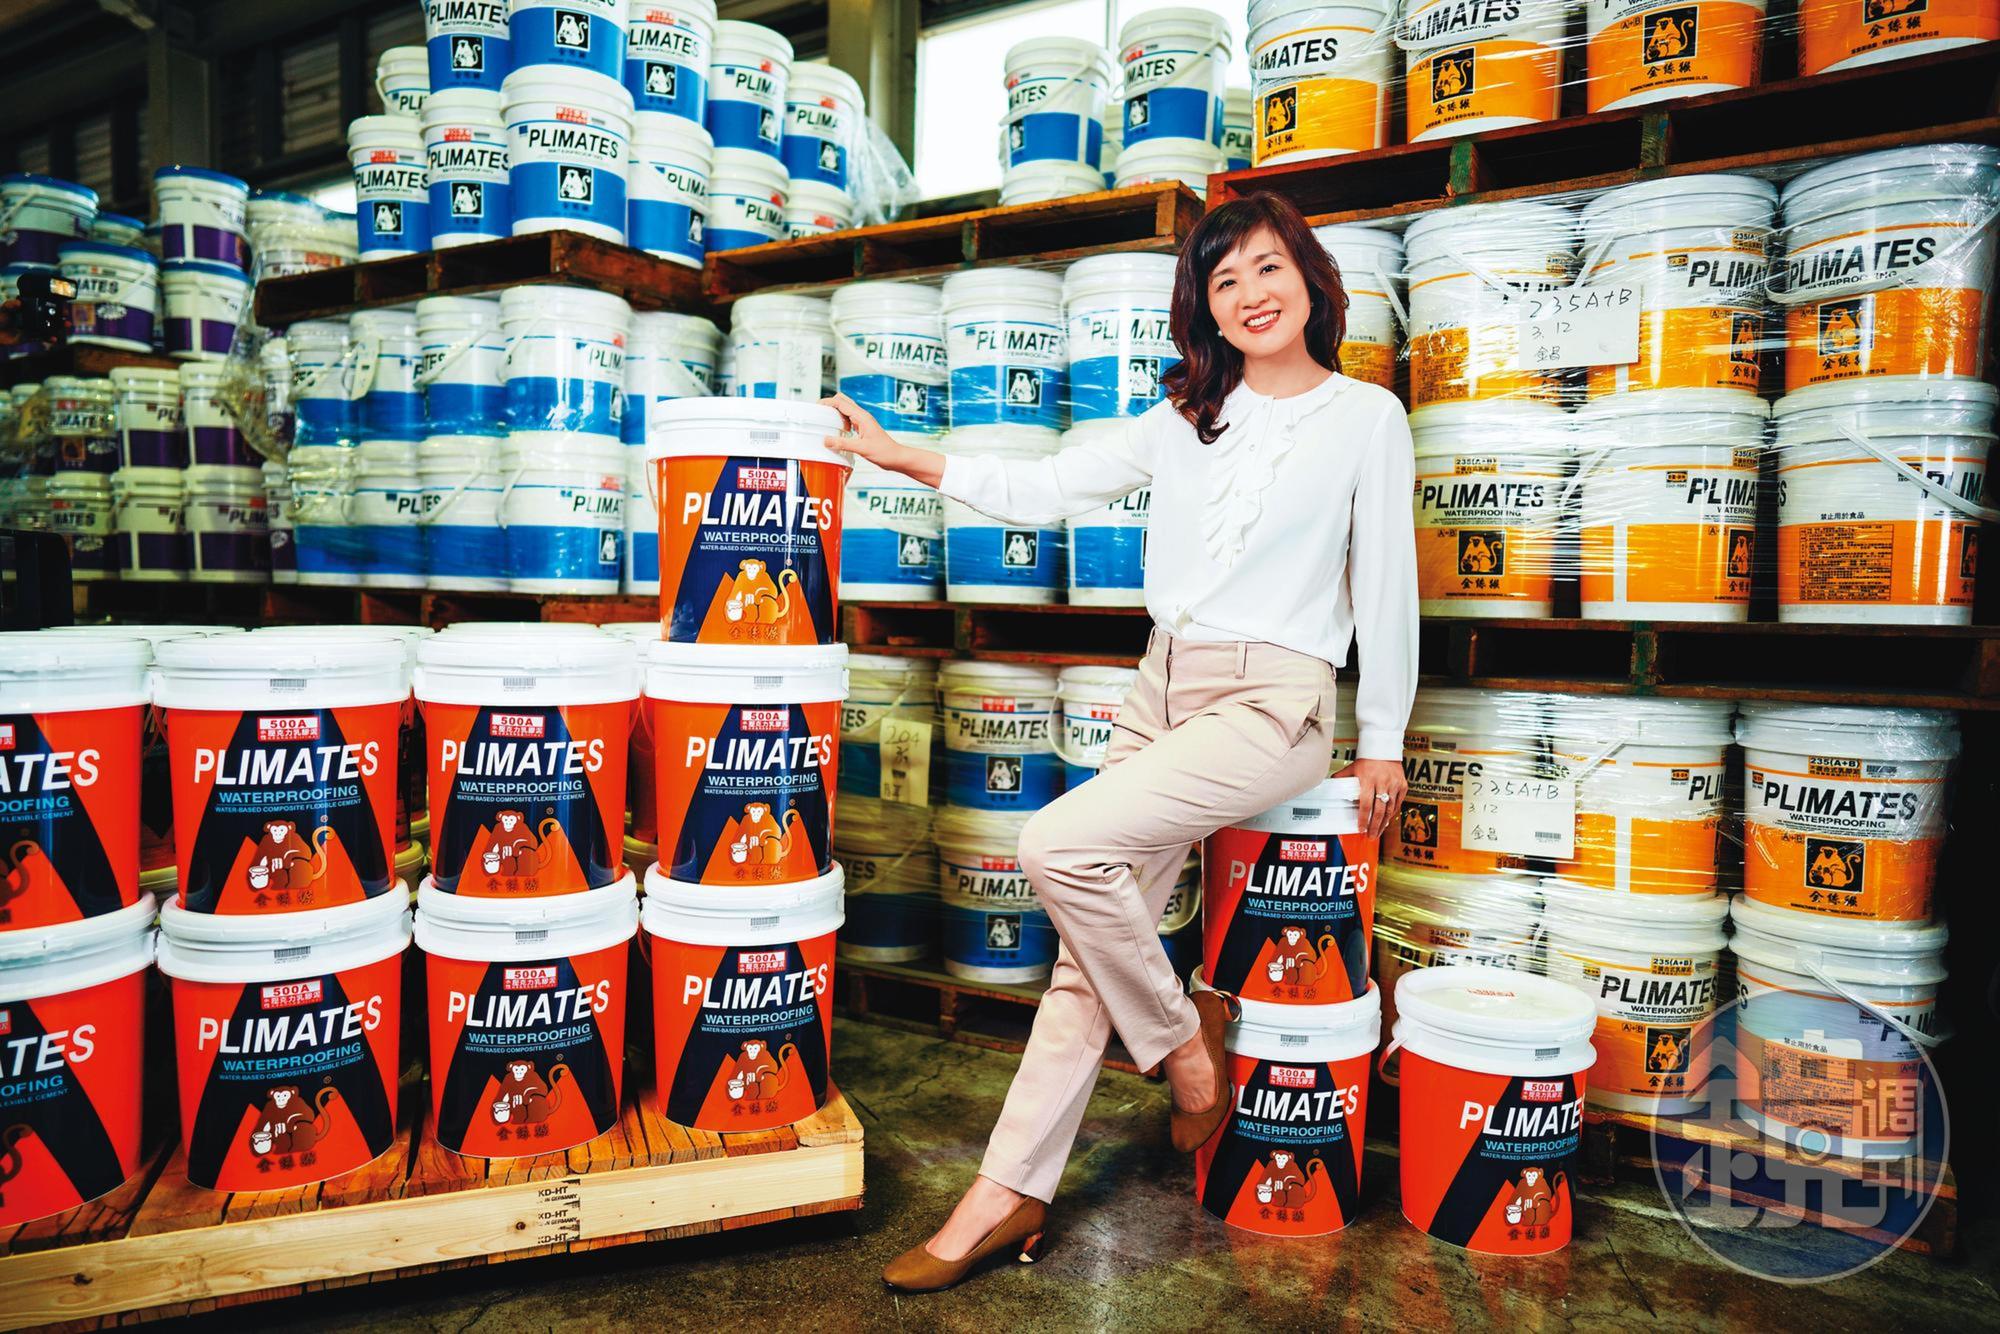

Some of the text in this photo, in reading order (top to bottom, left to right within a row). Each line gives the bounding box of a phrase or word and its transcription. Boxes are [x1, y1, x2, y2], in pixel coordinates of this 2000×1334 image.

[529, 129, 619, 158] PLIMATES
[1790, 237, 1936, 289] PLIMATES
[1529, 288, 1632, 318] 235A+B
[748, 470, 777, 479] 500A
[1422, 483, 1544, 510] PLIMATES
[682, 491, 833, 531] PLIMATES
[704, 531, 816, 546] WATERPROOFING
[270, 720, 307, 729] 500A
[501, 717, 533, 726] 500A
[750, 712, 780, 720] 500A
[960, 718, 1050, 739] PLIMATES
[441, 738, 605, 776] PLIMATES
[686, 734, 832, 771] PLIMATES
[194, 741, 379, 786] PLIMATES
[1810, 758, 1860, 768] 235(A+B)
[460, 780, 583, 794] WATERPROOFING
[708, 773, 817, 787] WATERPROOFING
[219, 785, 358, 804] WATERPROOFING
[533, 794, 561, 802] FLEXIBLE
[1472, 781, 1559, 799] 235A+B
[263, 804, 305, 813] COMPOSITE
[338, 798, 361, 807] CEMENT
[1764, 781, 1918, 820] PLIMATES
[1, 810, 75, 823] FLEXIBLE CEMENT
[1790, 813, 1886, 829] WATERPROOFING
[1228, 860, 1370, 897] PLIMATES
[1248, 898, 1353, 912] WATERPROOFING
[748, 955, 777, 963] 500A
[1653, 958, 1692, 966] 235(A+B)
[514, 970, 546, 979] 500A
[273, 985, 310, 996] 500A
[683, 964, 828, 1009] PLIMATES
[1601, 975, 1717, 1005] PLIMATES
[448, 979, 610, 1028] PLIMATES
[1631, 1005, 1704, 1014] WATERPROOFING
[198, 994, 382, 1054] PLIMATES
[705, 1005, 813, 1025] WATERPROOFING
[469, 1023, 590, 1045] WATERPROOFING
[775, 1022, 798, 1030] FLEXIBLE
[0, 1024, 96, 1079] TES
[465, 1035, 593, 1053] WATER-BASED COMPOSITE FLEXIBLE CEMENT
[223, 1042, 361, 1071] WATERPROOFING
[266, 1069, 308, 1080] COMPOSITE
[309, 1062, 340, 1074] FLEXIBLE
[340, 1054, 364, 1066] CEMENT
[1279, 1069, 1306, 1078] 500A
[1231, 1084, 1359, 1122] LIMATES
[1238, 1120, 1342, 1136] WATERPROOFING
[1485, 1134, 1579, 1152] WATERPROOFING
[538, 1186, 568, 1198] KD-HT
[551, 1194, 577, 1202] GERMANY
[538, 1210, 568, 1220] KD-HT
